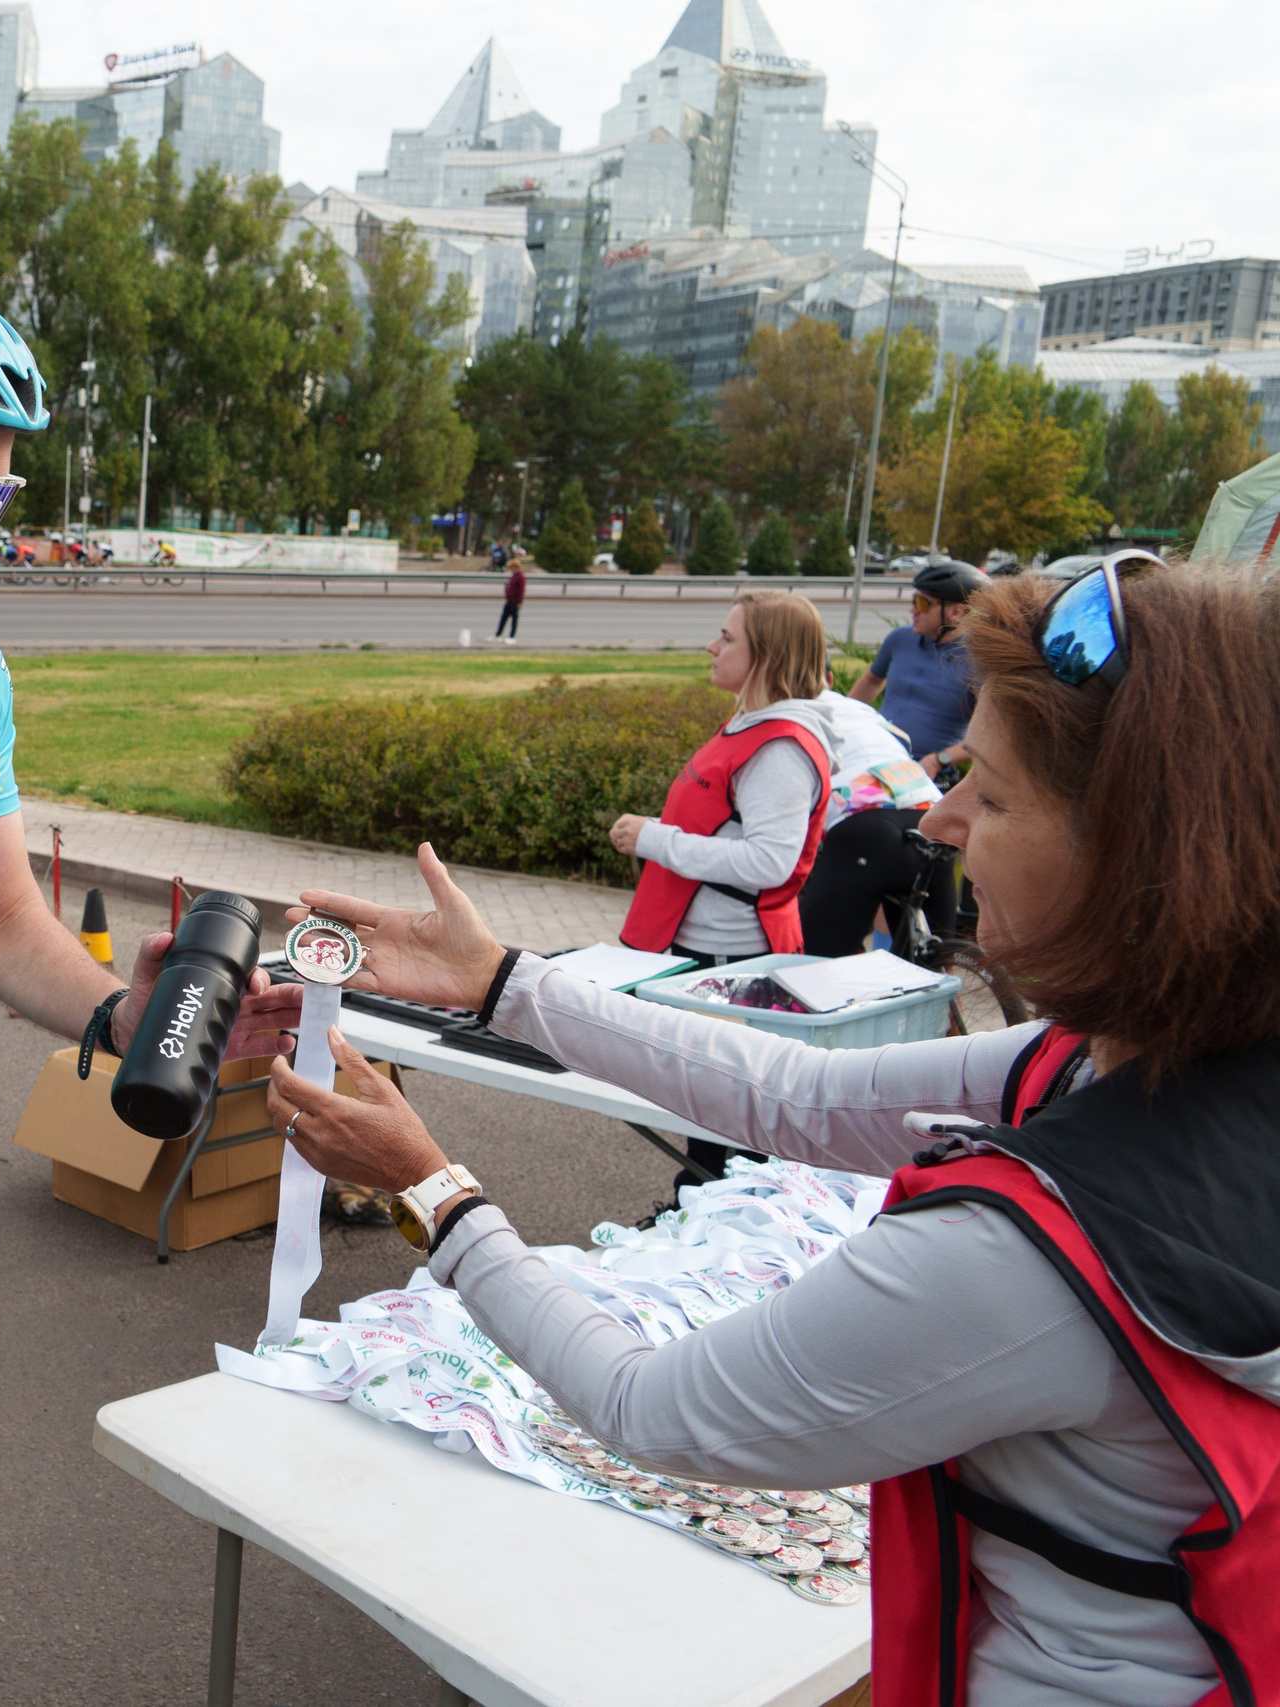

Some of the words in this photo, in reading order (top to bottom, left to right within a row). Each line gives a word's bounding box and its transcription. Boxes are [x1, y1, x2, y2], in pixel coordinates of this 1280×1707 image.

[1123, 239, 1215, 270] BYD
[304, 919, 355, 941] FINISHER
[166, 982, 205, 1039] Halyk
[360, 1330, 377, 1341] Gran
